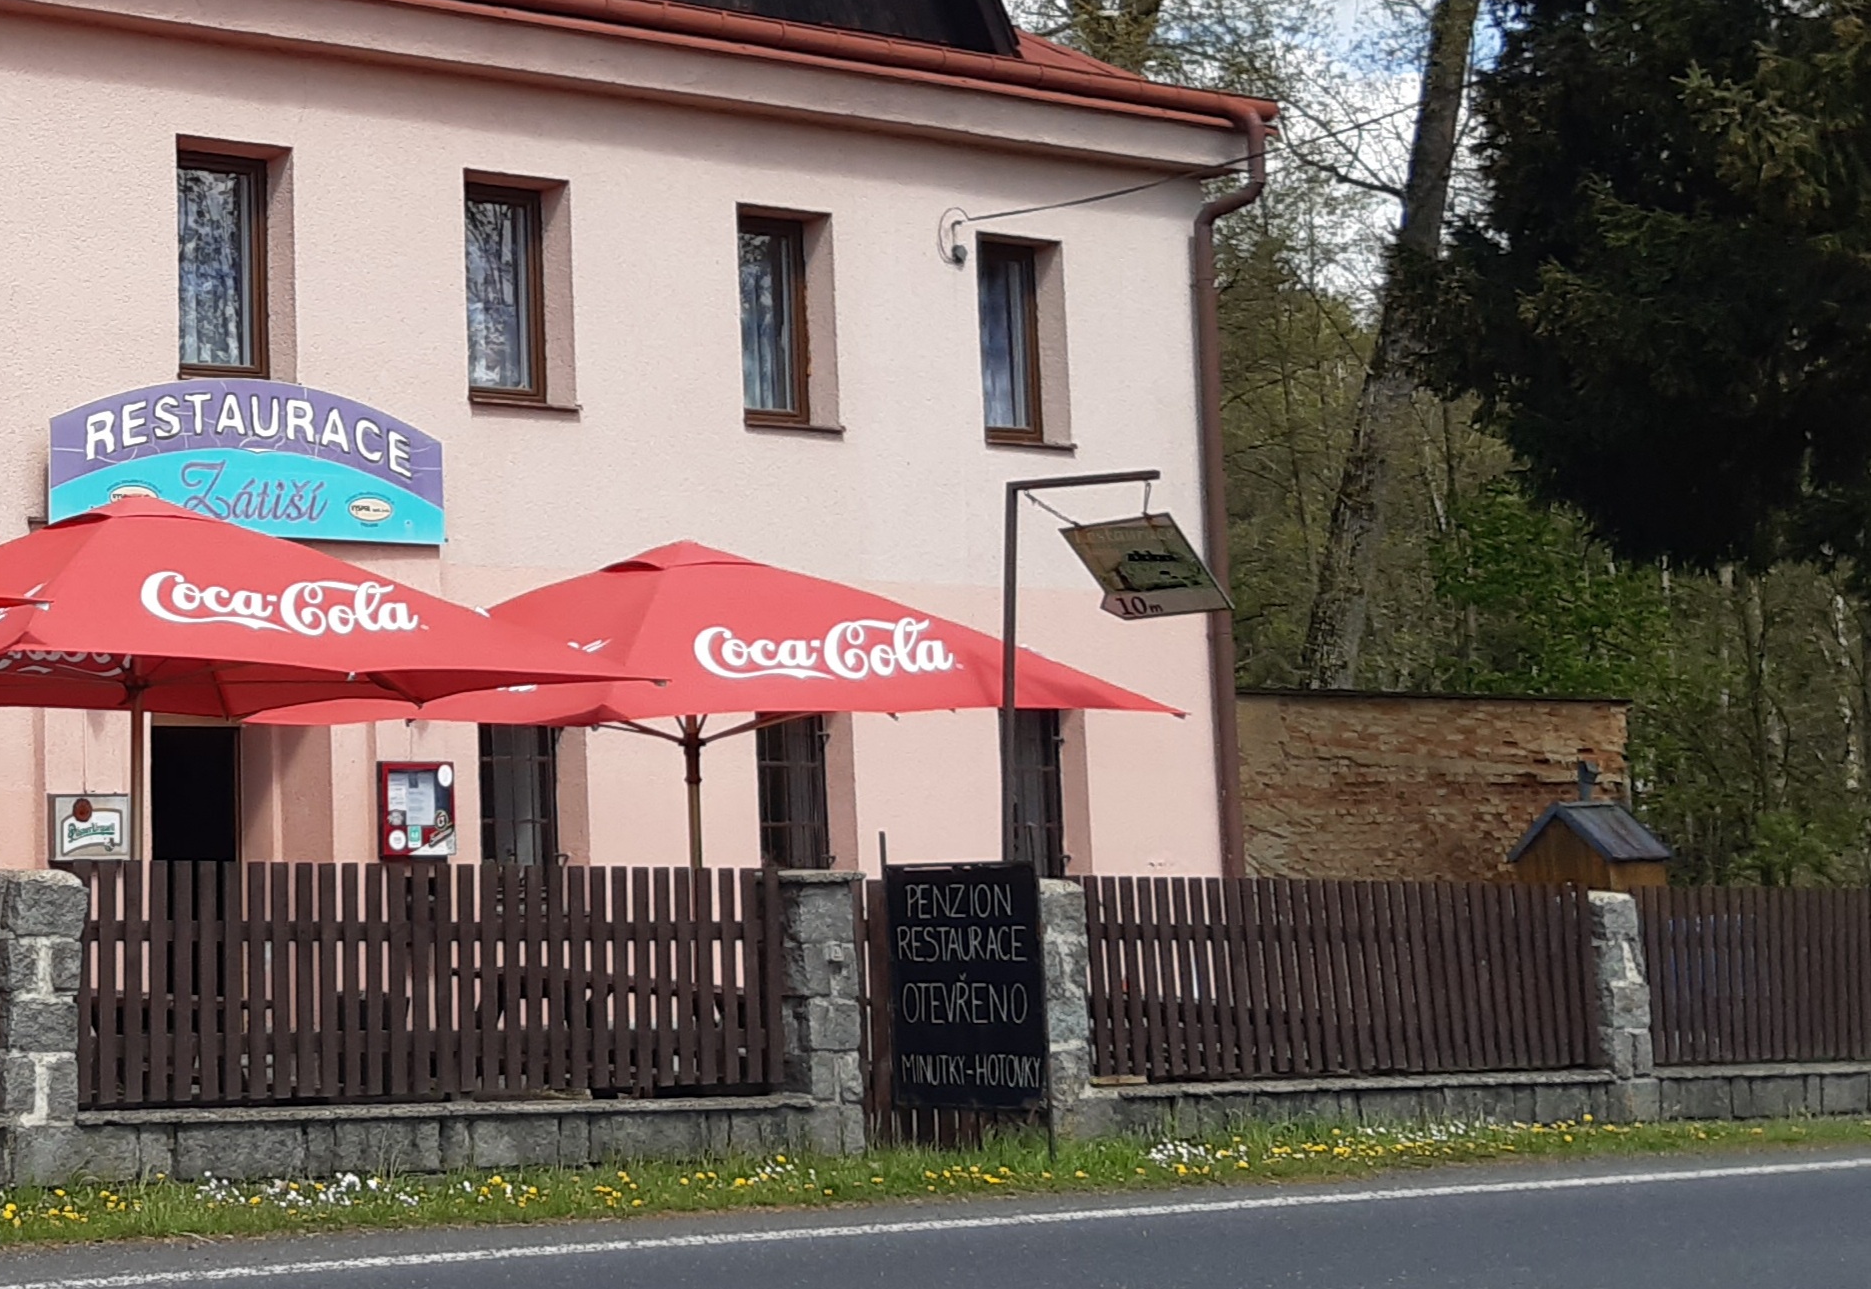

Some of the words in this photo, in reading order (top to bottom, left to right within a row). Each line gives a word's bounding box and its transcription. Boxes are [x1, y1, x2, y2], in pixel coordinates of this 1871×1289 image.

[85, 393, 413, 479] RESTAURACE
[180, 459, 329, 523] Zátiší
[139, 570, 419, 637] Coca-Cola
[1114, 595, 1148, 616] 10
[693, 616, 955, 680] Coca-Cola
[904, 883, 1013, 920] PENZION
[896, 925, 1028, 962] RESTAURACE
[902, 972, 1029, 1025] OTEVŘENO
